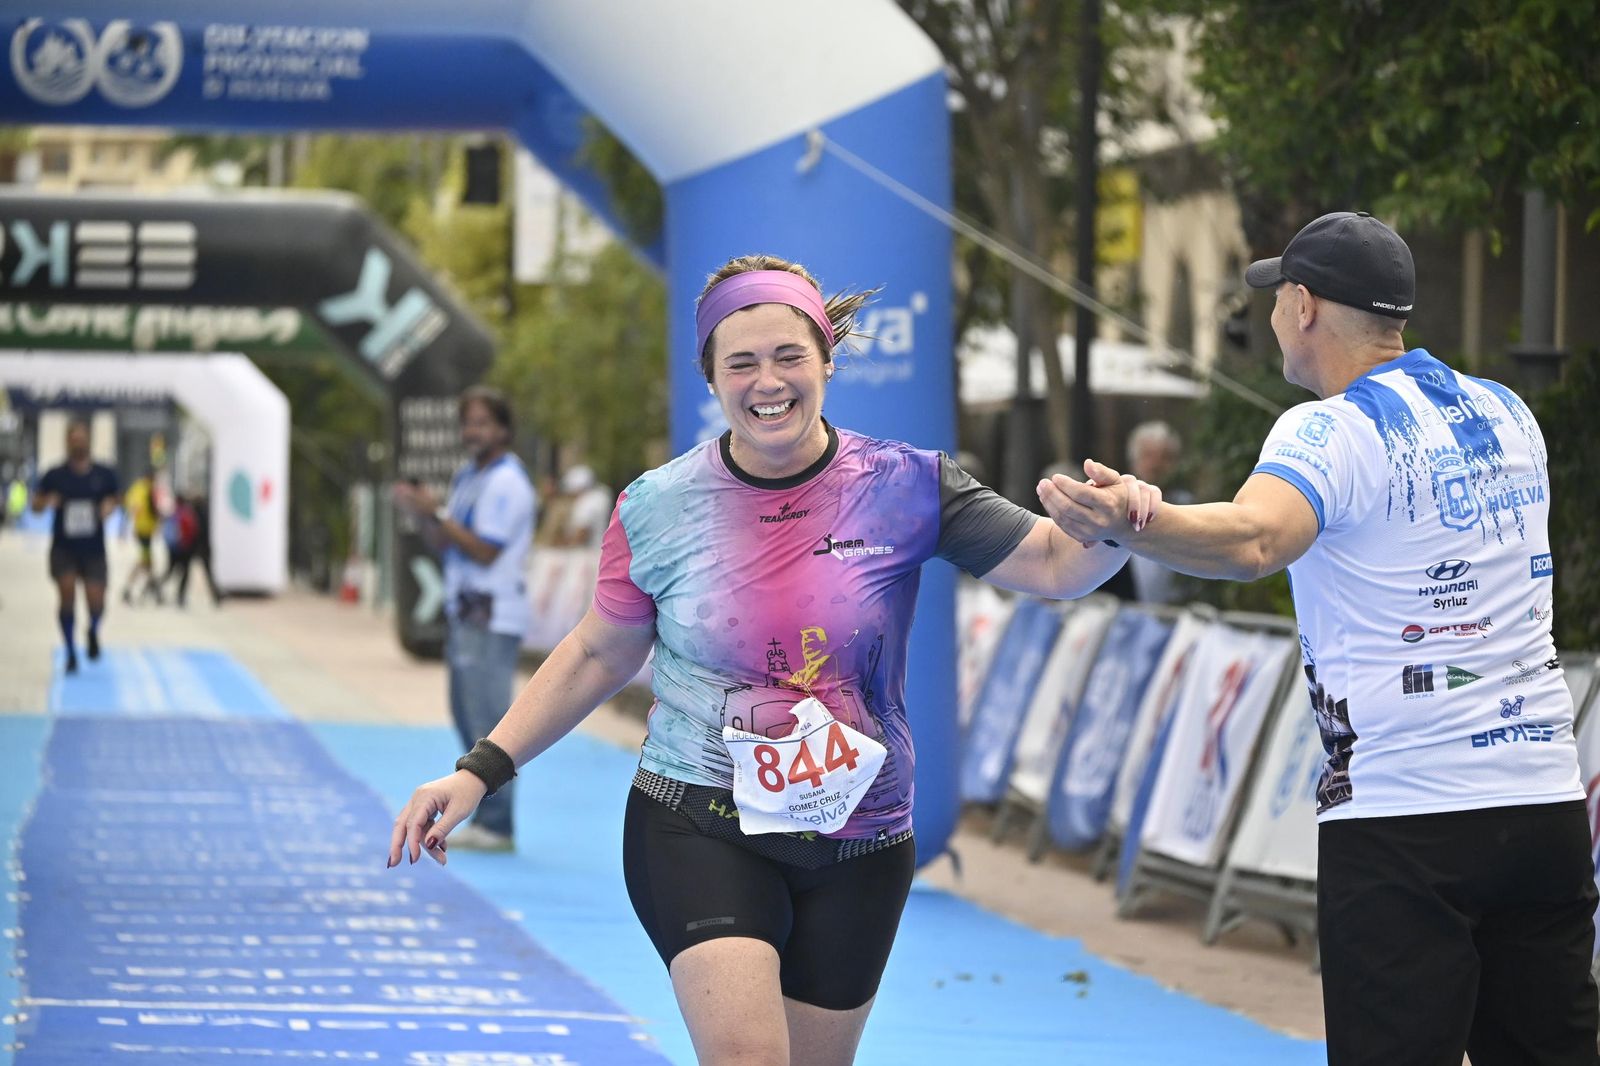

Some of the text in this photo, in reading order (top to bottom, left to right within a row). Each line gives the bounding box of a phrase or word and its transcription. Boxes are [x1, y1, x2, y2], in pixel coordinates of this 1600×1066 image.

[0, 220, 199, 290] KEE
[1372, 301, 1396, 311] UNDER
[1411, 393, 1496, 428] Huelva
[1486, 484, 1545, 513] HUELVA
[843, 545, 894, 558] GANES
[1418, 580, 1479, 597] HYUNDAI
[1433, 596, 1468, 610] Syrluz
[753, 721, 860, 793] 844
[788, 791, 841, 812] GOMEZ CRUZ
[799, 788, 826, 801] SUSANA
